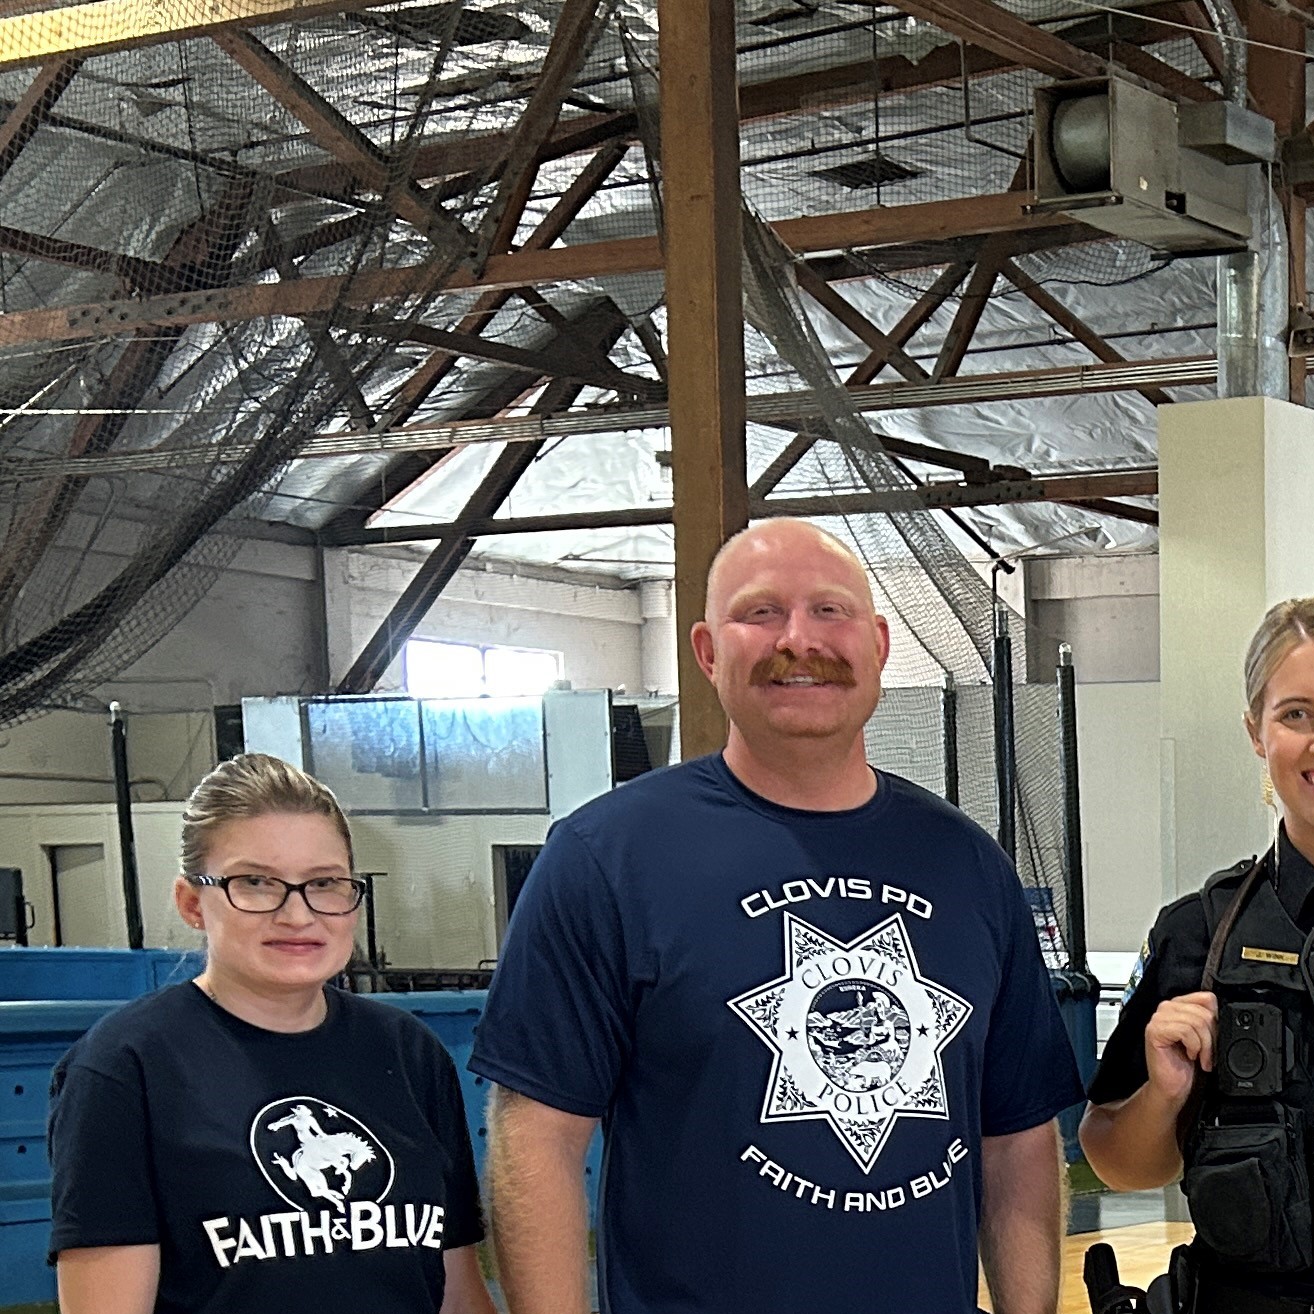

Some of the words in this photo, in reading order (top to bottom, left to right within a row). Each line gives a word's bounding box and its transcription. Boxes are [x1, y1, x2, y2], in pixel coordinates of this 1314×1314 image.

[740, 876, 873, 919] CLOVIS
[881, 884, 933, 920] PD
[801, 956, 904, 989] CLOVIS
[817, 1076, 912, 1115] POLICE
[740, 1144, 836, 1210] FAITH
[843, 1186, 905, 1213] AND
